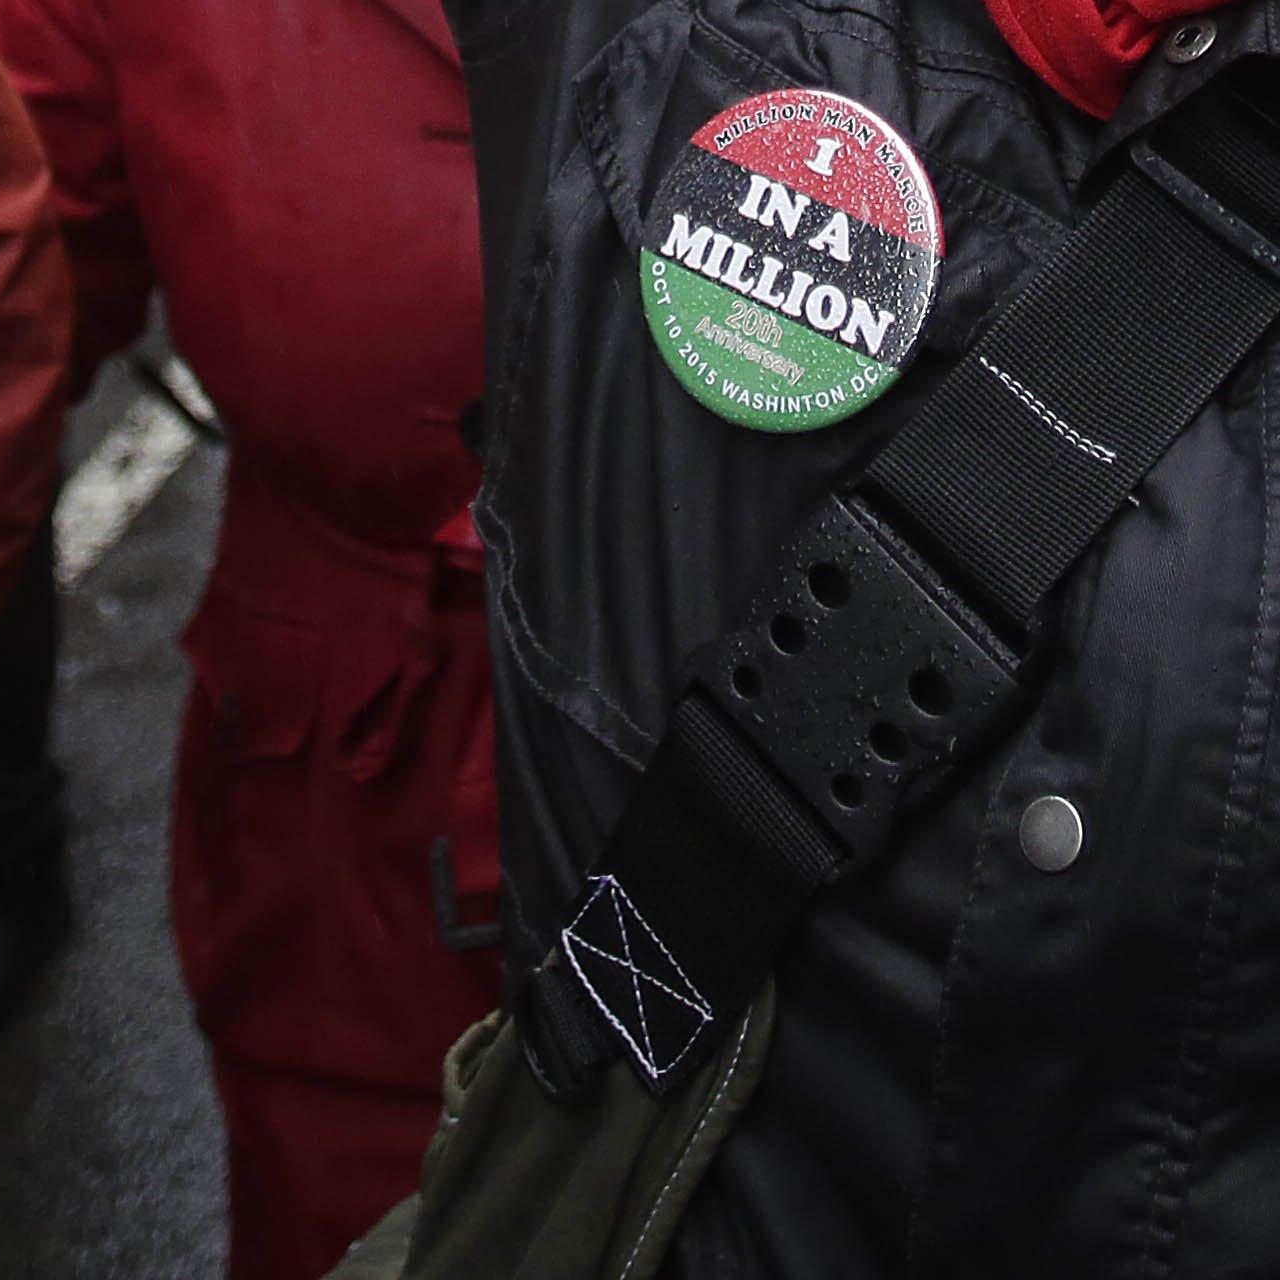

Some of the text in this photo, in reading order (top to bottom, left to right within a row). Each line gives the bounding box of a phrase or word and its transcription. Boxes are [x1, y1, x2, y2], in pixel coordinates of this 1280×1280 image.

[714, 103, 928, 234] MILLION MAN MARCH
[737, 173, 852, 264] IN A
[651, 260, 673, 306] OCT
[663, 314, 683, 341] 10
[678, 342, 719, 386] 2015
[721, 380, 846, 414] WASHINTON
[659, 213, 896, 355] MILLION
[724, 299, 783, 348] 20th
[695, 315, 804, 385] Anniversary
